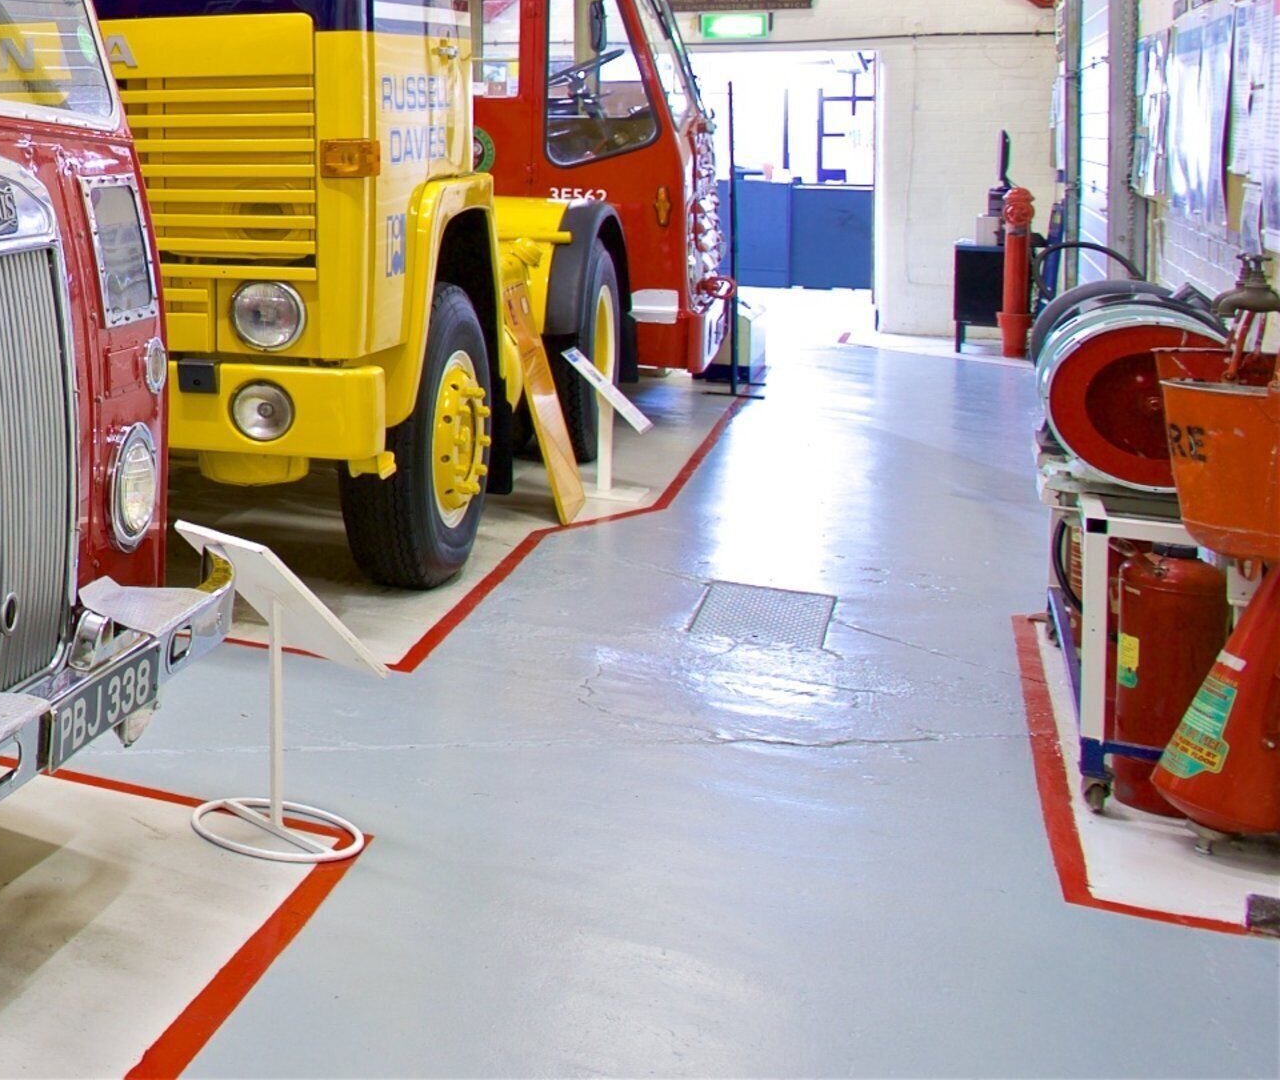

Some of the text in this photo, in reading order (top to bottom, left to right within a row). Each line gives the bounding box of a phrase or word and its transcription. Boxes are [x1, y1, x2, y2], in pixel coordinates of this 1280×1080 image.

[382, 76, 450, 111] RUSSELL
[390, 127, 446, 164] DAVIES
[60, 659, 150, 761] PBJ 338
